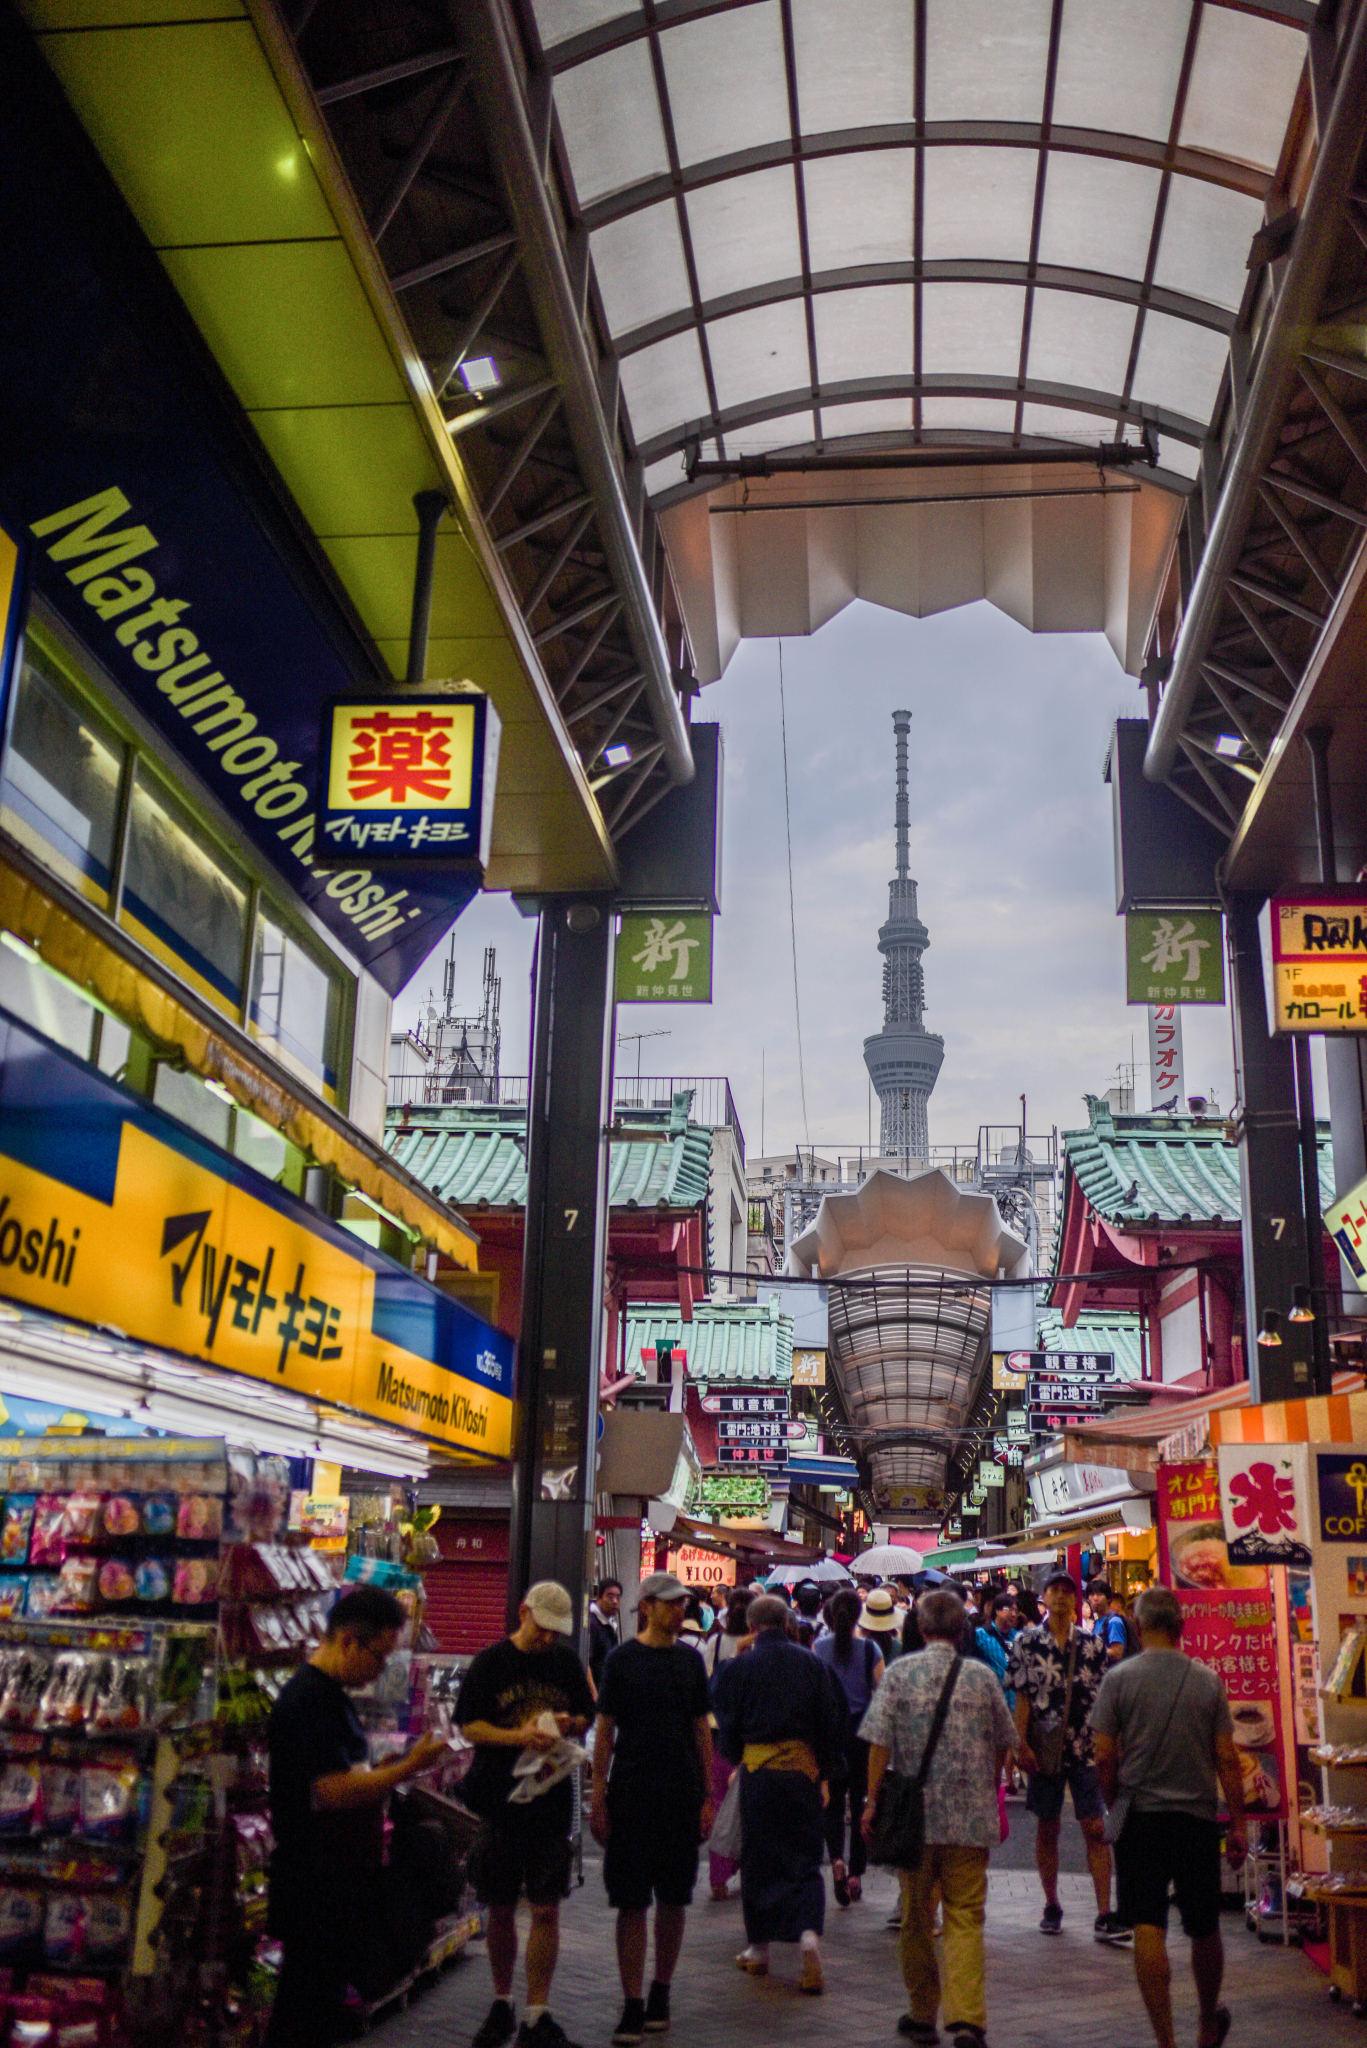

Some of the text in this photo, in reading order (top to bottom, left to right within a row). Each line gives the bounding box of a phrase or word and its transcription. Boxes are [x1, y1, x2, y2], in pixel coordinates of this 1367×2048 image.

[29, 486, 308, 819] Matsumoto
[347, 711, 454, 802] 薬
[324, 815, 470, 849] マツモトキヨシ
[1281, 907, 1299, 918] 2F
[632, 918, 700, 980] 新
[1140, 918, 1211, 981] 新
[1285, 969, 1302, 980] 1F
[636, 985, 693, 997] 新仲見世
[1147, 986, 1206, 999] 新仲見世
[1285, 1002, 1356, 1019] カロール
[1154, 1004, 1179, 1090] カラオケ
[564, 1210, 578, 1231] 7
[1270, 1218, 1286, 1240] 7
[160, 1210, 343, 1374] マツモトキヨシ
[797, 1353, 821, 1377] 新
[1045, 1355, 1097, 1370] 観音様
[376, 1362, 450, 1425] Matsumoto
[450, 1394, 489, 1437] KiYoshi
[732, 1398, 775, 1411] 観音様
[727, 1423, 781, 1436] 雷門:地下鉄
[732, 1448, 775, 1461] 仲見世
[686, 1566, 723, 1582] ¥100
